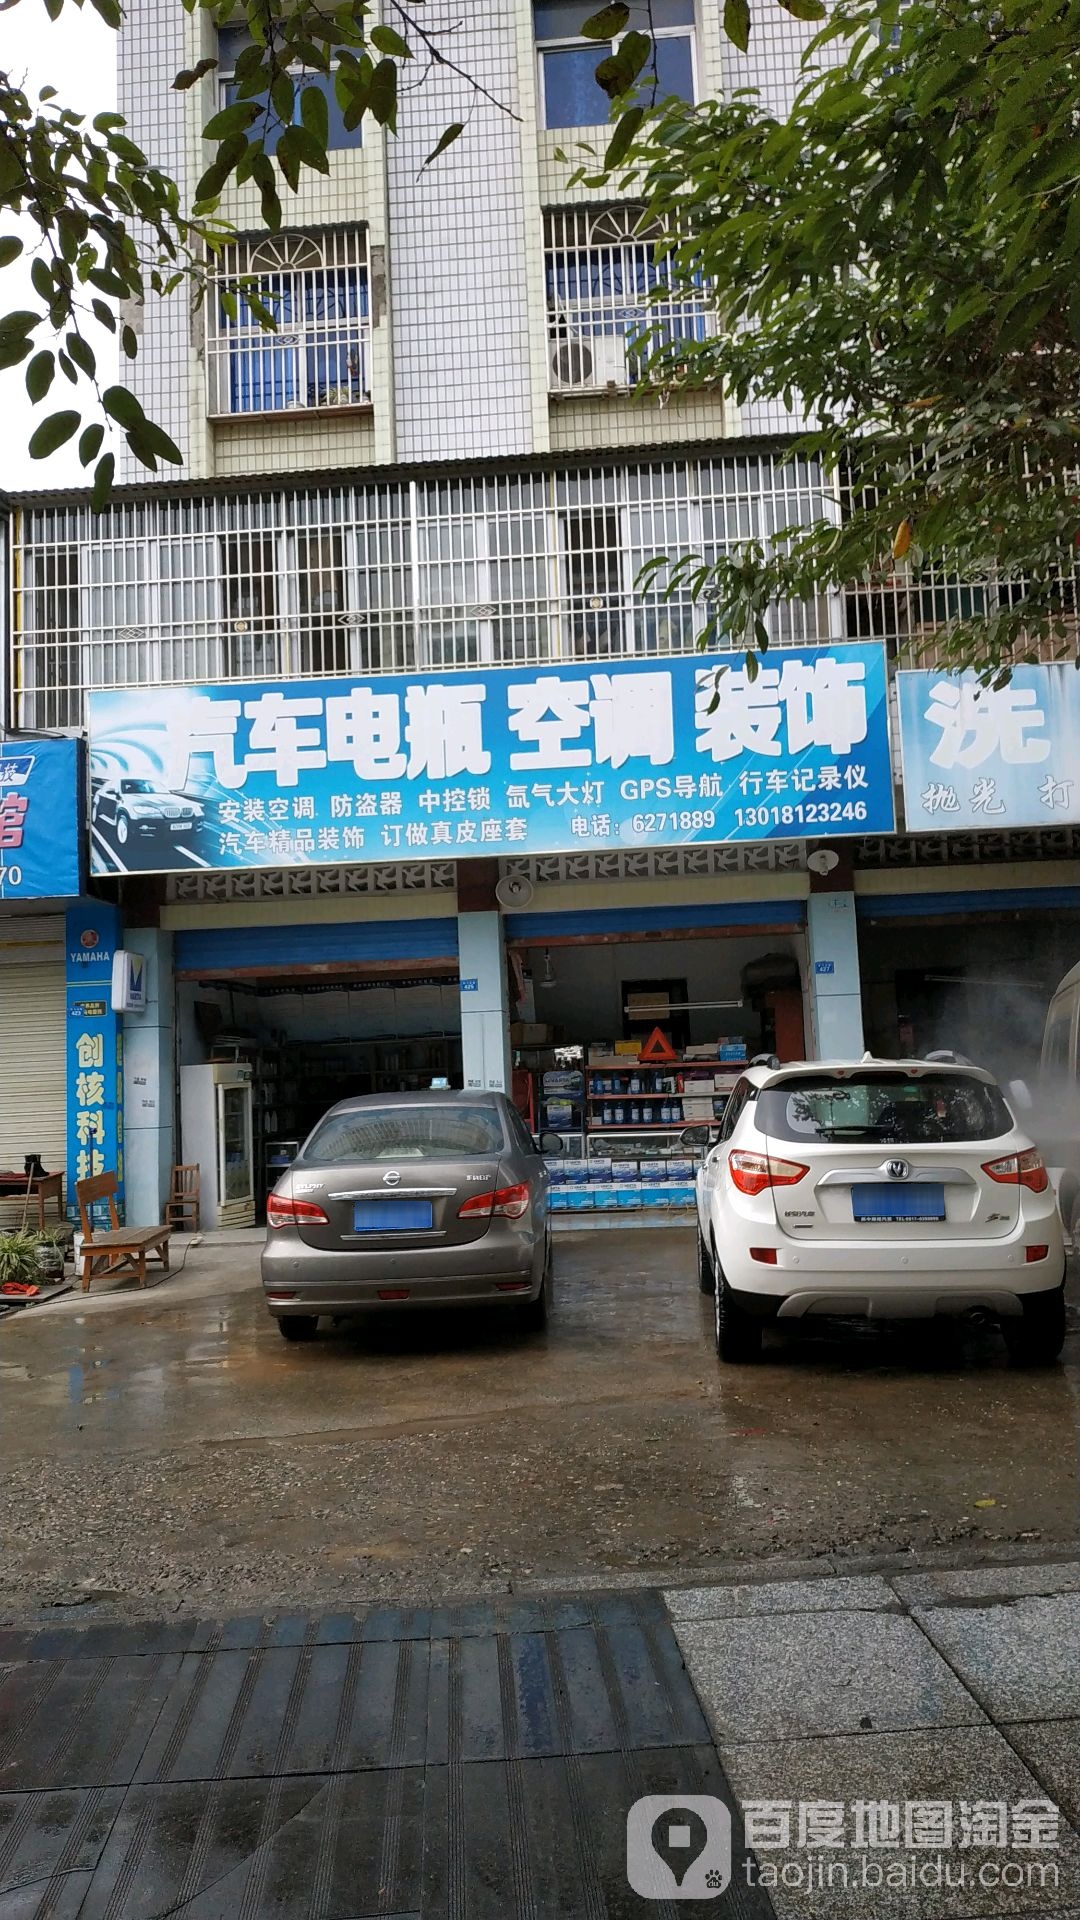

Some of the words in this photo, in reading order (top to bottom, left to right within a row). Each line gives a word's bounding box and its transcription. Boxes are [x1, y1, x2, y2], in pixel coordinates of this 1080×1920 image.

[166, 684, 491, 790] 汽车电瓶
[507, 671, 674, 771] 空调
[695, 657, 868, 763] 装饰
[923, 680, 1050, 770] 洗
[0, 763, 18, 782] 技
[218, 796, 315, 825] 安装空调
[330, 791, 402, 818] 防盗器
[418, 786, 491, 815] 中控锁
[506, 779, 604, 809] 氙气大灯
[620, 773, 723, 800] GPS导航
[739, 764, 869, 796] 行车记录仪
[921, 777, 1006, 815] 抛光
[1037, 775, 1075, 810] 打
[219, 826, 365, 856] 汽车精品装饰
[381, 818, 527, 847] 订做真皮座套
[632, 810, 715, 834] 6271889
[735, 801, 867, 828] 13018123246
[71, 951, 110, 963] YAMAHA
